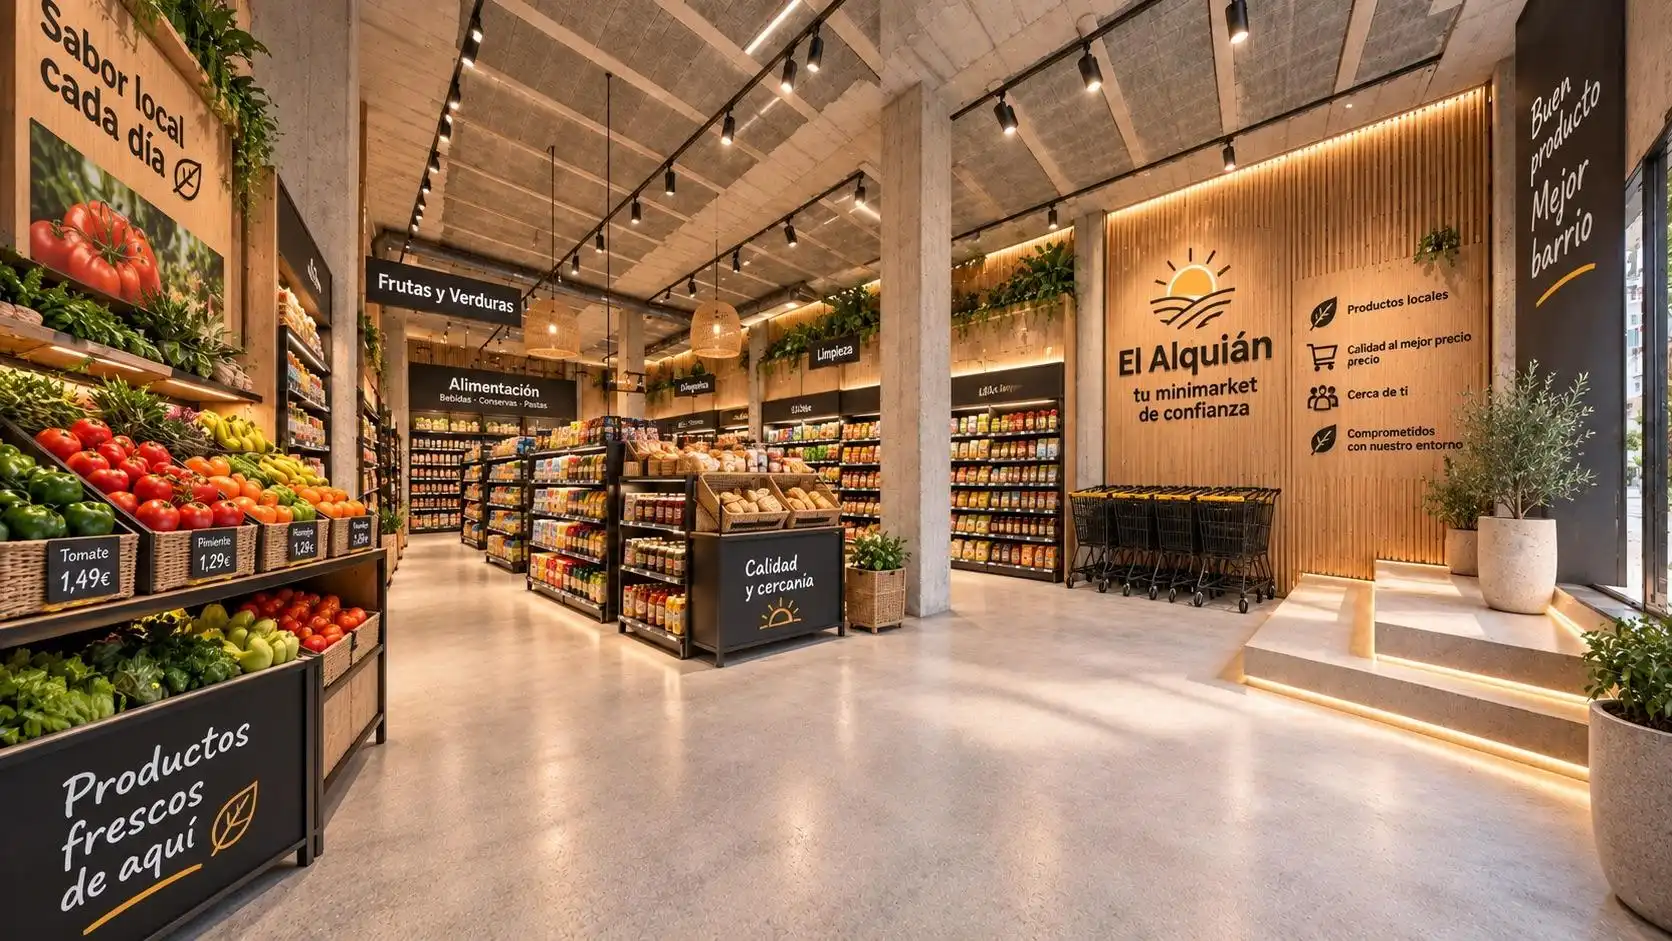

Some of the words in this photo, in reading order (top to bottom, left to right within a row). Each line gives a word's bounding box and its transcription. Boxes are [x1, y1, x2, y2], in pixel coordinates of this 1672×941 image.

[41, 0, 129, 96] Sabor
[135, 75, 184, 149] local
[41, 58, 119, 141] cada
[128, 123, 165, 178] día
[1531, 76, 1571, 140] Buen
[1530, 79, 1600, 187] producto
[1531, 159, 1589, 232] Mejor
[1531, 208, 1593, 279] barrio
[378, 273, 432, 298] Frutas
[436, 288, 445, 304] y
[450, 288, 514, 313] Verduras
[1347, 298, 1404, 315] Productos
[1407, 290, 1449, 304] locales
[817, 345, 853, 361] Limpieza
[1119, 348, 1142, 377] El
[1149, 331, 1273, 377] Alquián
[1347, 342, 1386, 355] Calidad
[1388, 339, 1398, 352] al
[1400, 336, 1432, 351] mejor
[1434, 332, 1472, 347] precio
[1347, 354, 1380, 368] precio
[449, 377, 540, 398] Alimentación
[1133, 387, 1150, 403] tu
[1156, 377, 1257, 402] minimarket
[1347, 389, 1379, 400] Cerca
[1382, 387, 1397, 398] de
[1399, 386, 1409, 397] ti
[439, 393, 472, 404] Bebidas
[478, 396, 518, 408] Conservas
[524, 400, 548, 409] Pastas
[1138, 406, 1159, 422] de
[1163, 402, 1250, 421] confianza
[1347, 426, 1435, 440] Comprometidos
[1347, 442, 1367, 452] con
[1370, 441, 1413, 452] nuestro
[1416, 440, 1464, 451] entorno
[60, 547, 109, 563] Tomate
[198, 536, 232, 549] Pimiente
[199, 552, 231, 572] 1,29€
[745, 554, 798, 577] Calidad
[61, 566, 111, 593] 1,49€
[745, 584, 754, 602] y
[757, 572, 814, 595] cercanía
[62, 722, 250, 818] Productos
[61, 781, 204, 872] frescos
[60, 867, 106, 912] de
[119, 816, 197, 878] aquí
